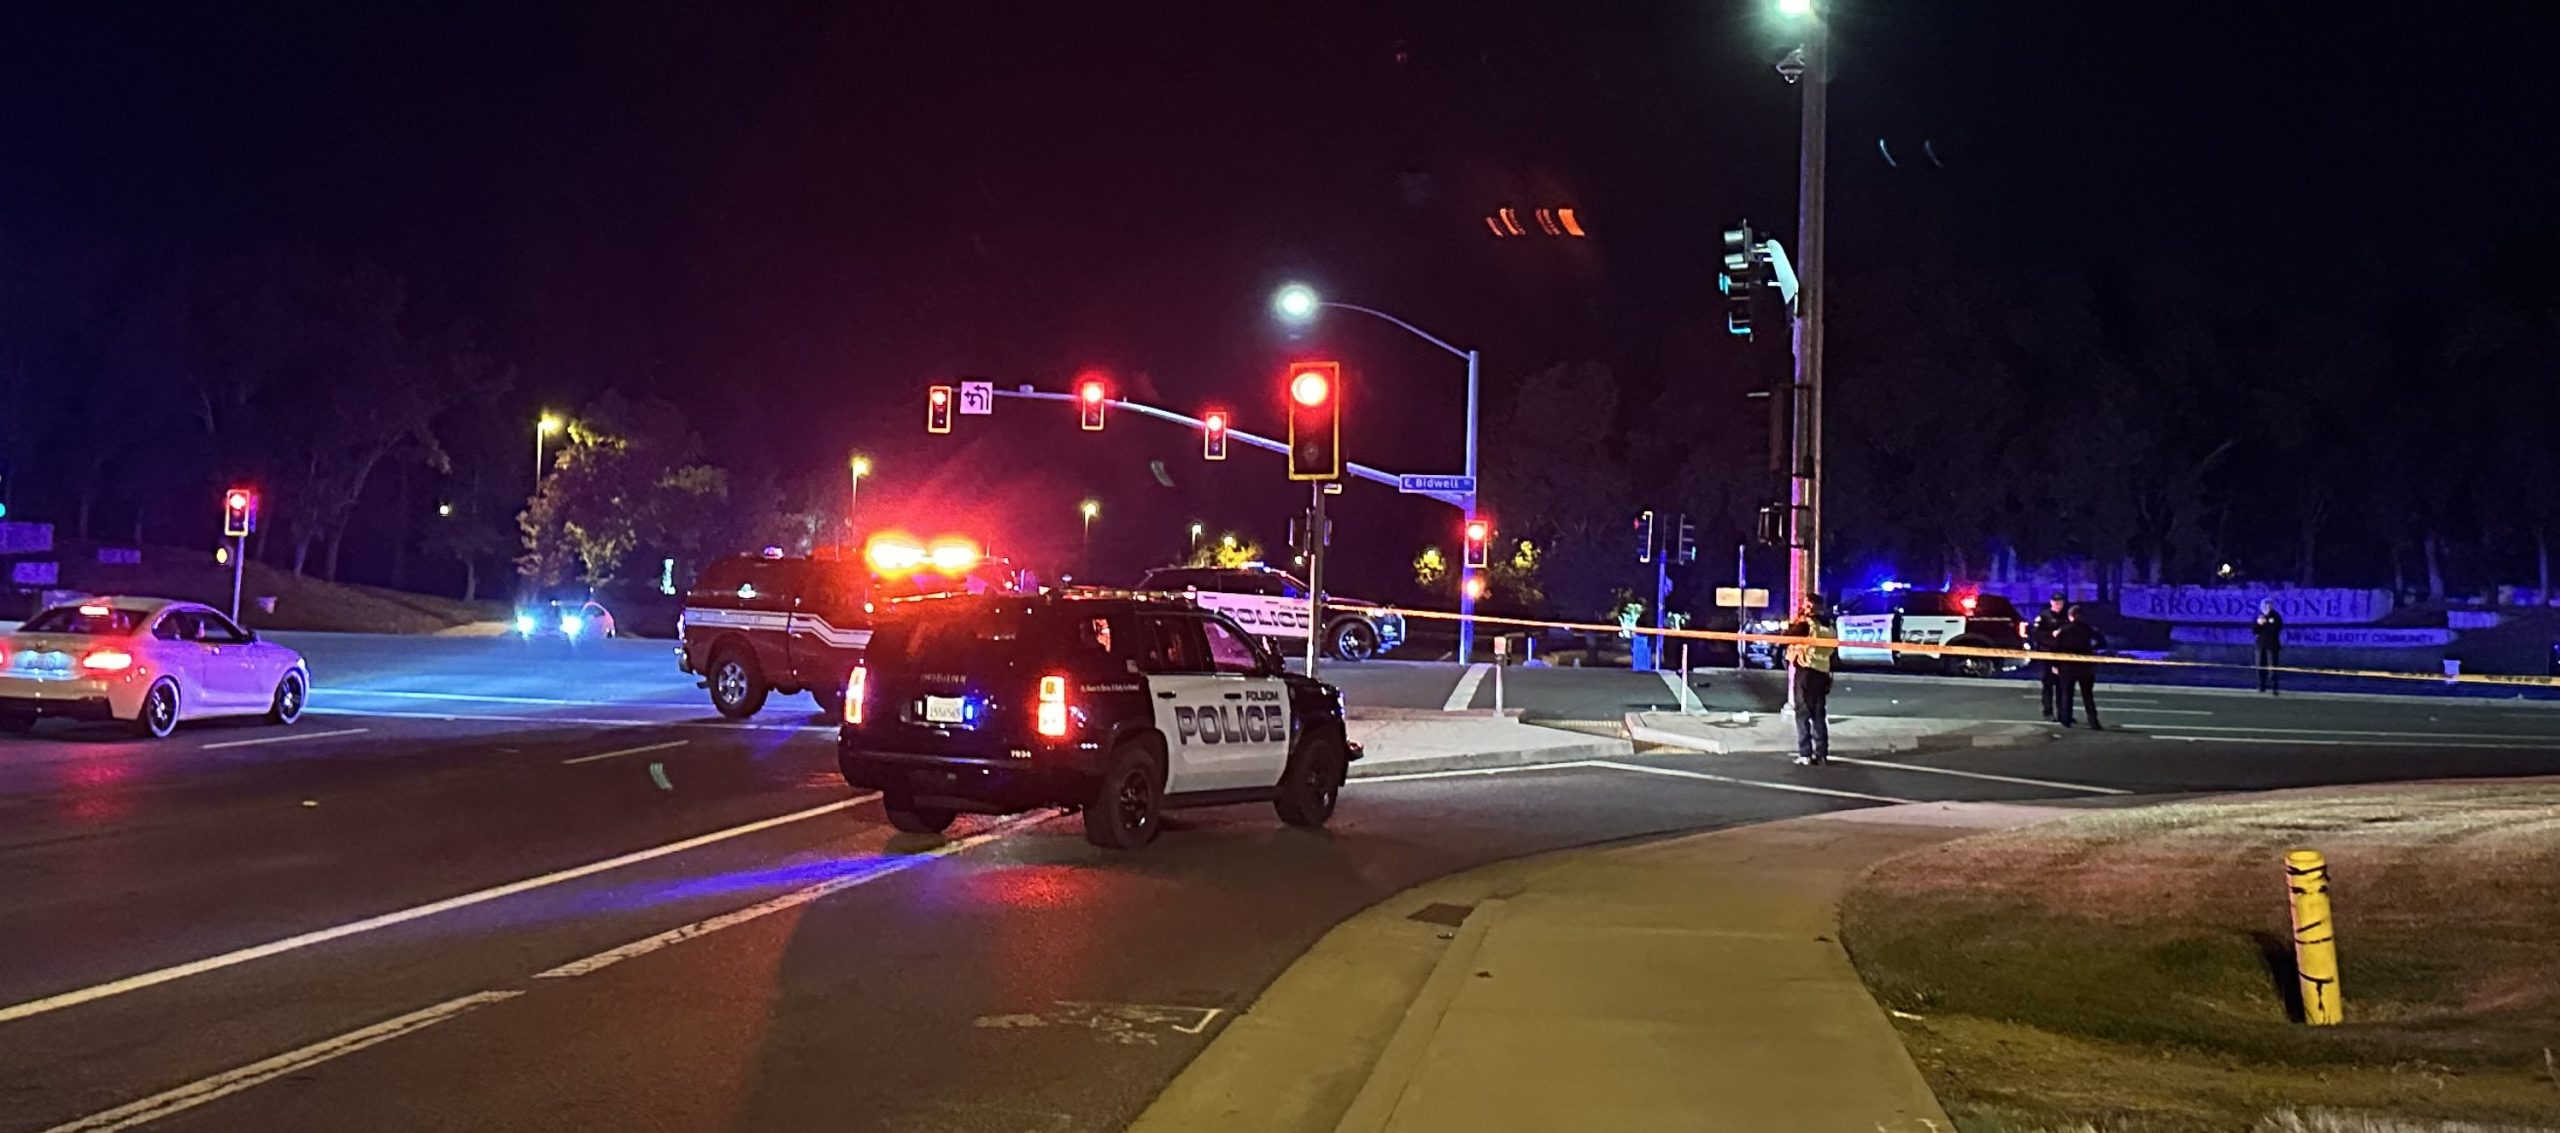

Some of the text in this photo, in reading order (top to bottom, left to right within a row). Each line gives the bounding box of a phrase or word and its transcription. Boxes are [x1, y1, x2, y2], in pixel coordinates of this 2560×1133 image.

[1416, 478, 1459, 489] Bidwell
[2149, 598, 2342, 617] BROADSONE
[1246, 691, 1279, 701] FOLSOM
[1175, 705, 1286, 746] POLICE
